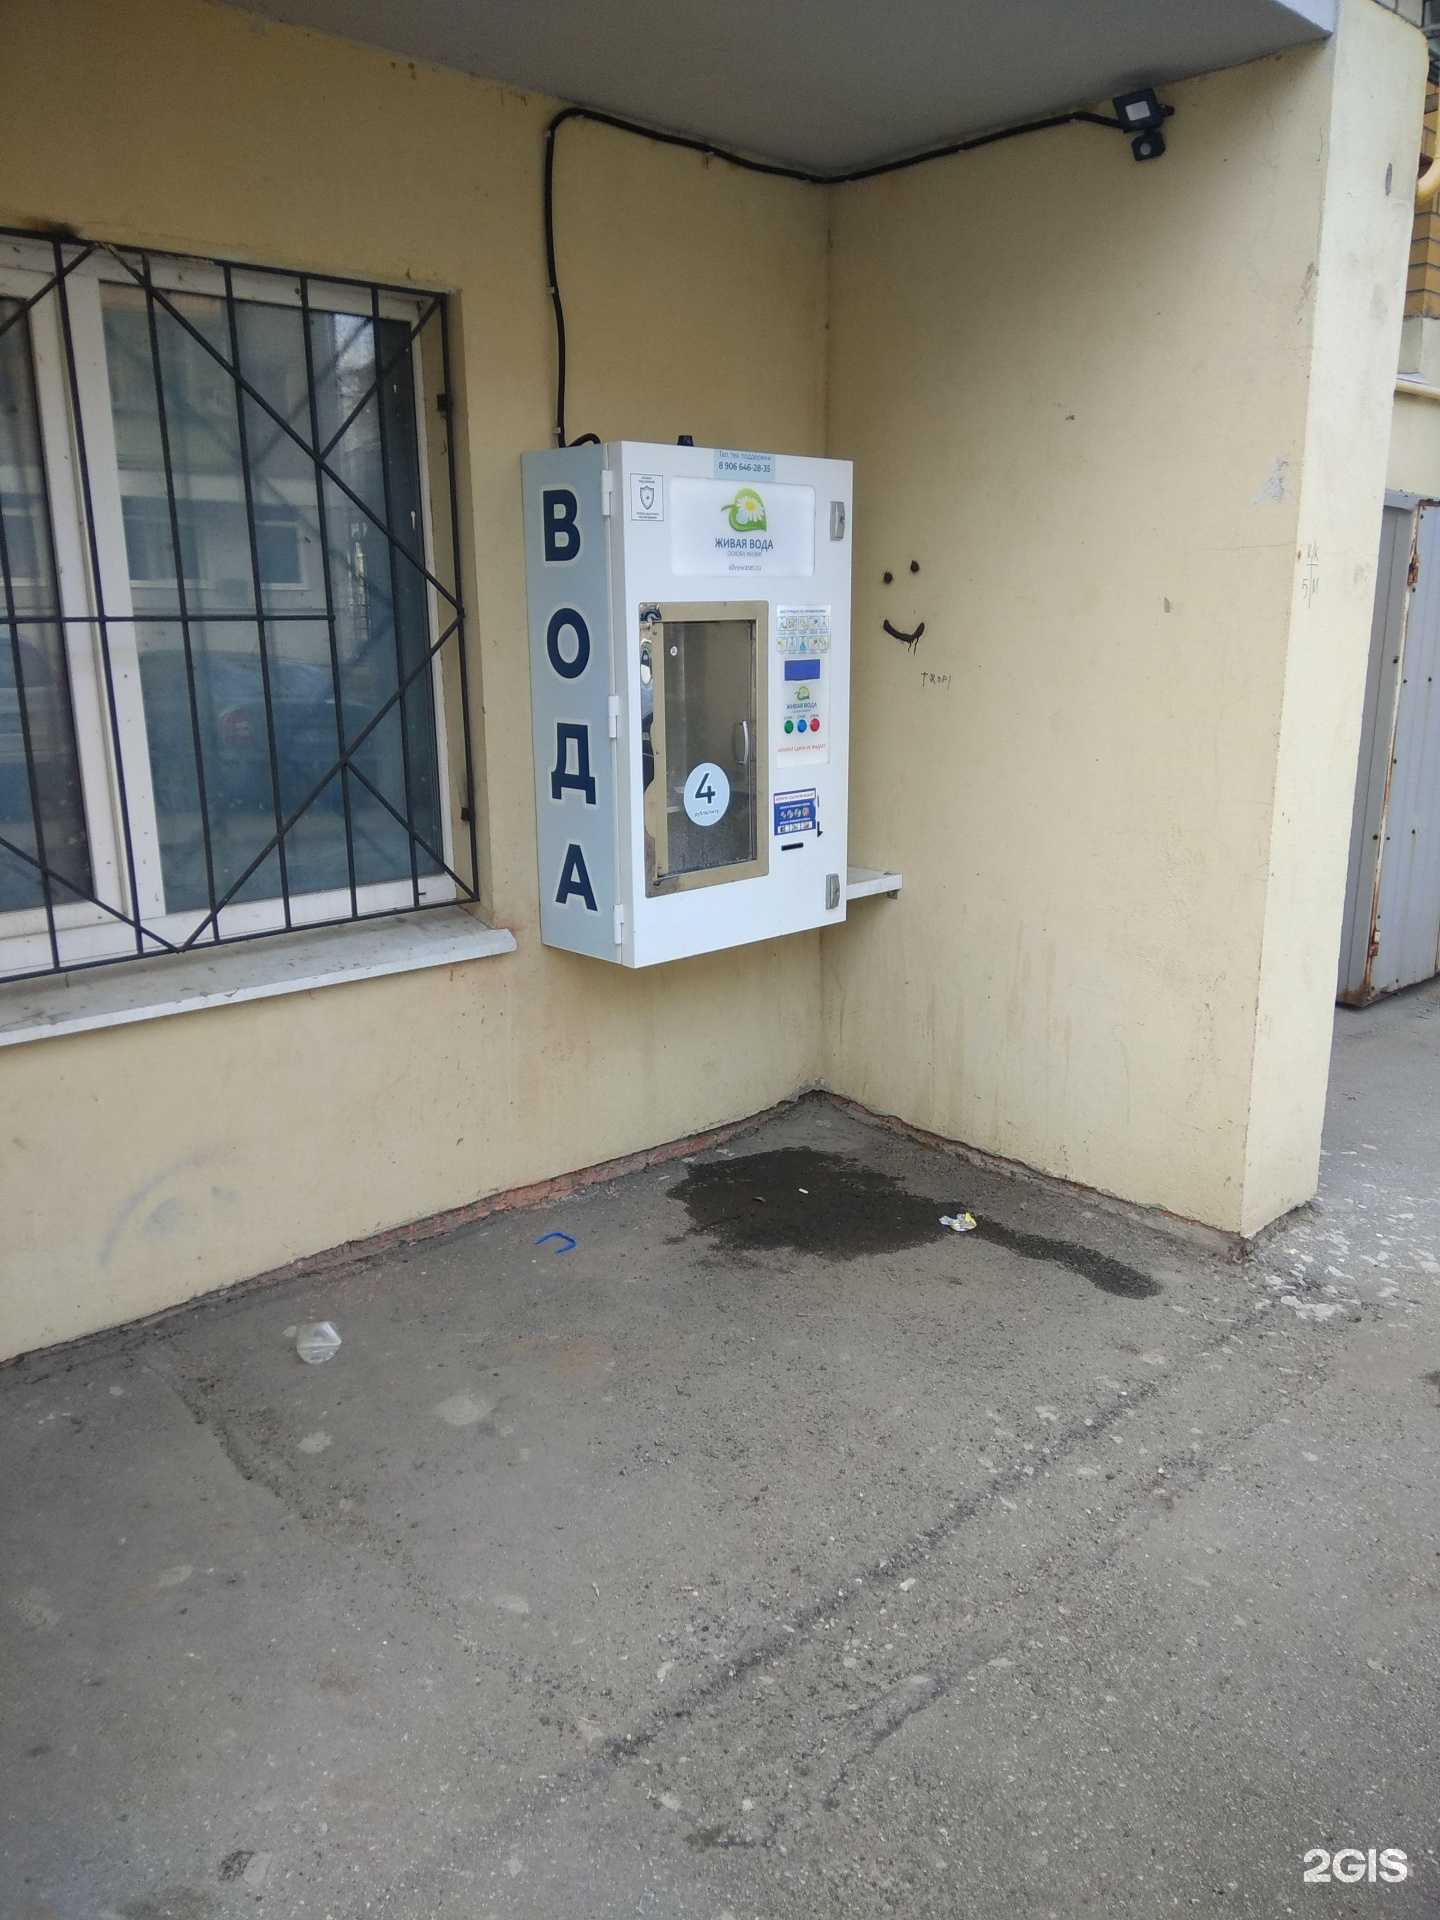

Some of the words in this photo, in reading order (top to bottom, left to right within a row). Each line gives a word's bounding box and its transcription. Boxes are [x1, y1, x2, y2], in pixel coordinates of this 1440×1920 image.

[714, 537, 747, 549] ЖИВАЯ
[749, 538, 774, 552] ВОДА
[543, 488, 598, 912] ВОДА
[695, 772, 716, 804] 4
